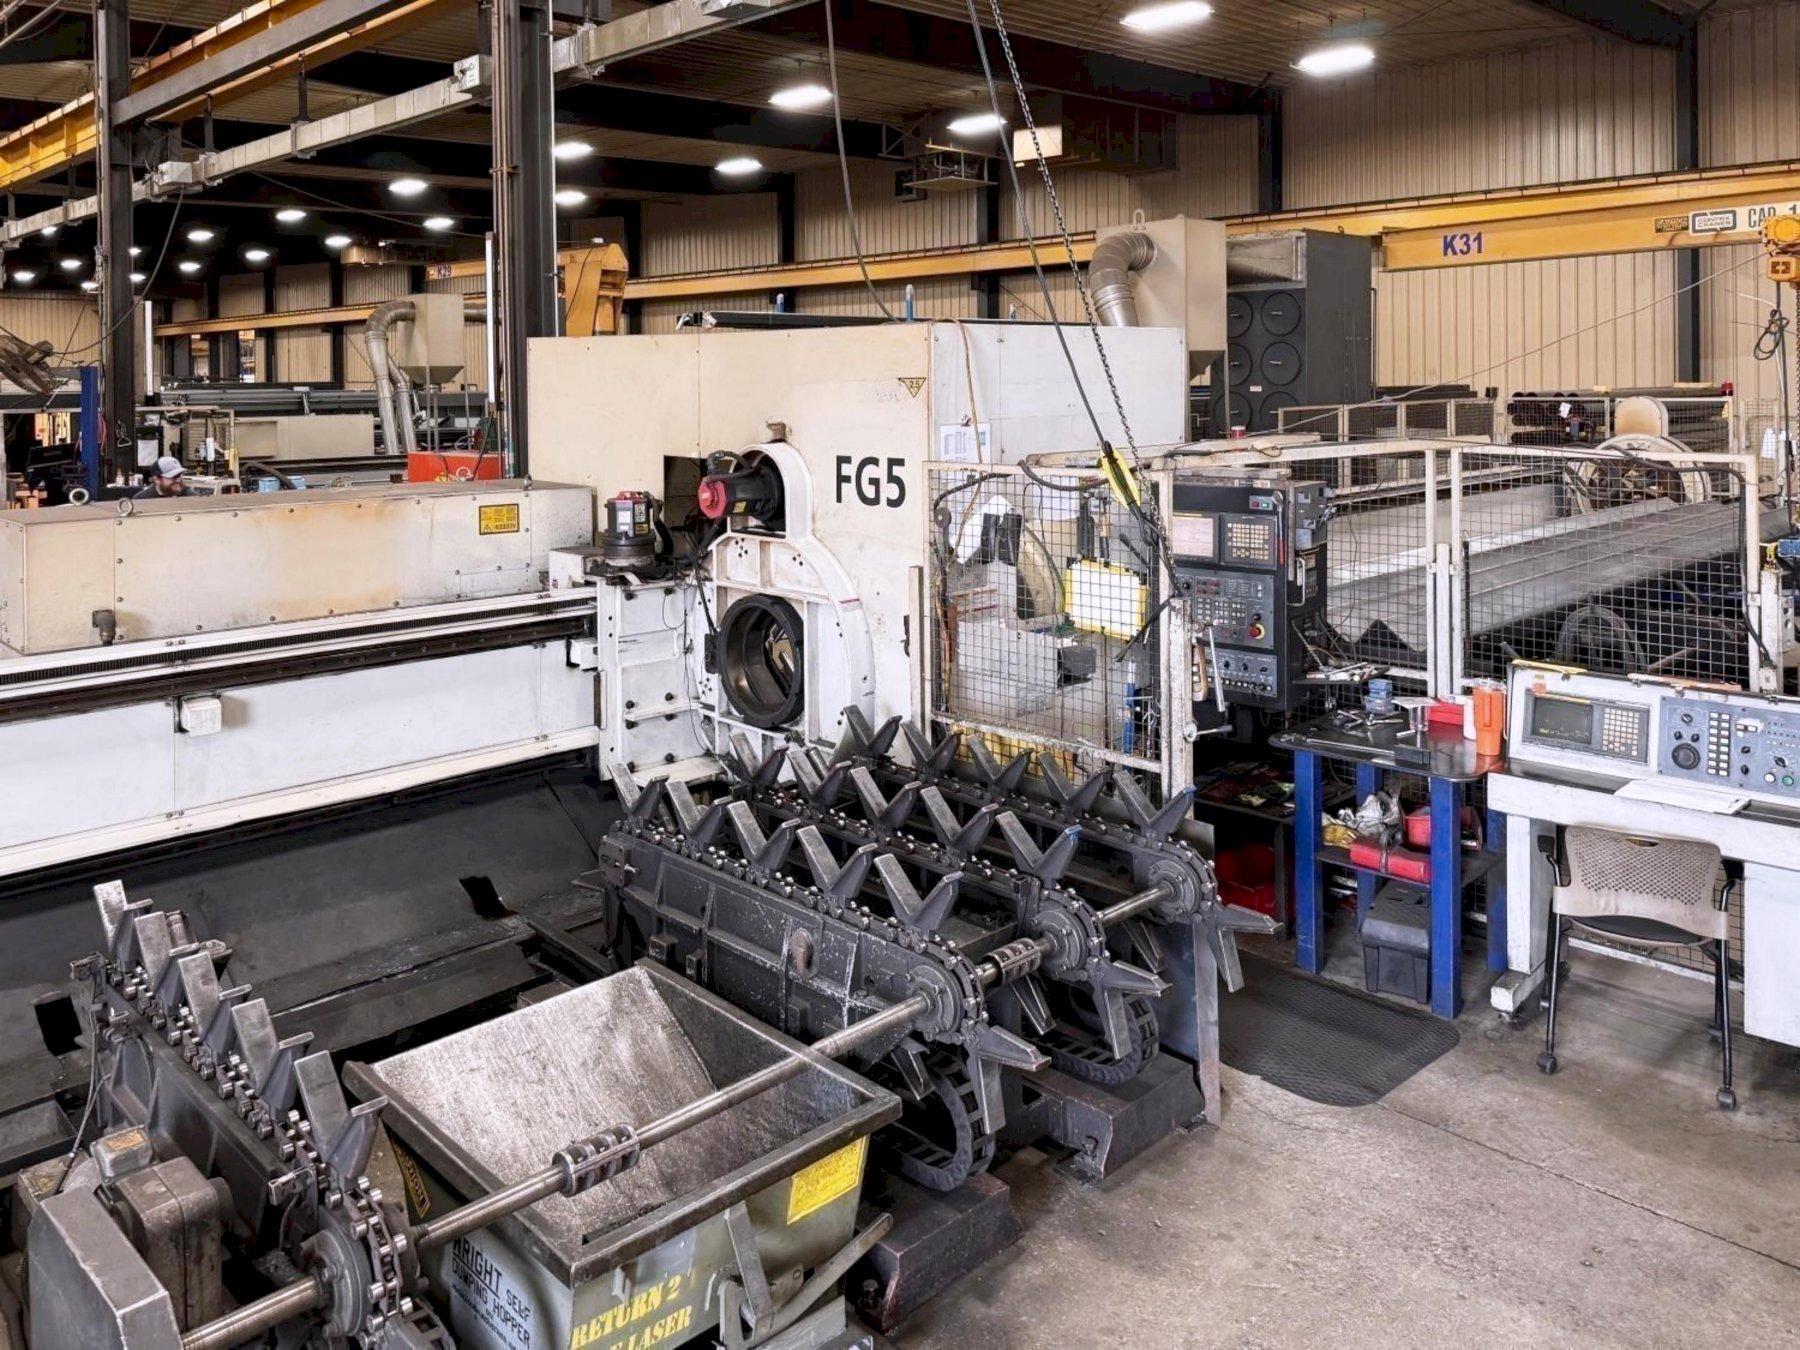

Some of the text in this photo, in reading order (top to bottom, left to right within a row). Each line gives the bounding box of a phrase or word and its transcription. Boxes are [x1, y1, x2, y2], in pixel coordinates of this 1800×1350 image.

[1443, 231, 1482, 257] K31
[836, 455, 906, 508] FG5
[452, 1258, 488, 1305] DUMPING
[492, 1298, 530, 1350] HOPPER
[506, 1288, 532, 1322] SELF
[570, 1283, 664, 1350] RETURN
[667, 1274, 682, 1300] 2
